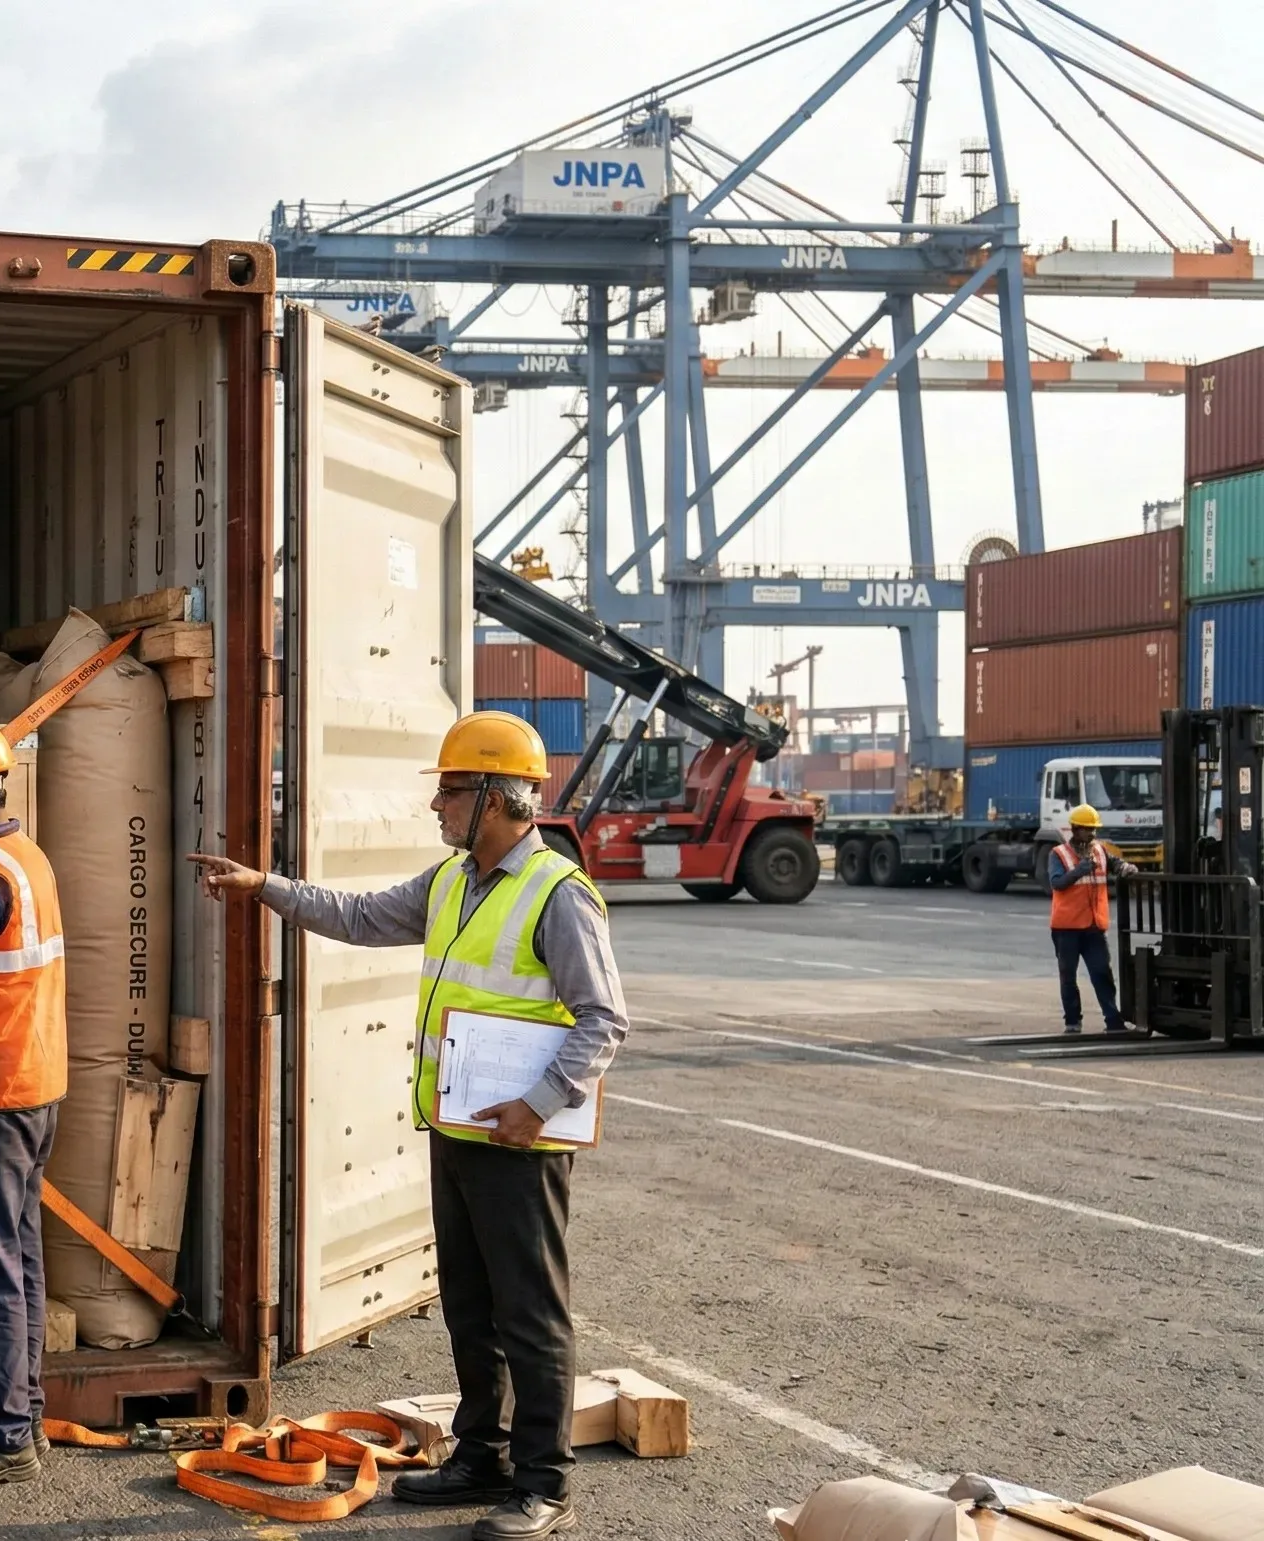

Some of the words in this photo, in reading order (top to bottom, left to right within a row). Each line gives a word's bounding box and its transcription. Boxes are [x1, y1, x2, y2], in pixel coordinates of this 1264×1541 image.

[553, 161, 645, 189] JNPA
[781, 247, 847, 269] JNPA
[346, 293, 416, 312] JNPA
[517, 356, 570, 372] JNPA
[155, 418, 165, 576] TRIU
[194, 400, 205, 570] INDU
[857, 583, 932, 607] JNPA
[128, 816, 147, 899] CARGO
[129, 907, 147, 999] SECURE
